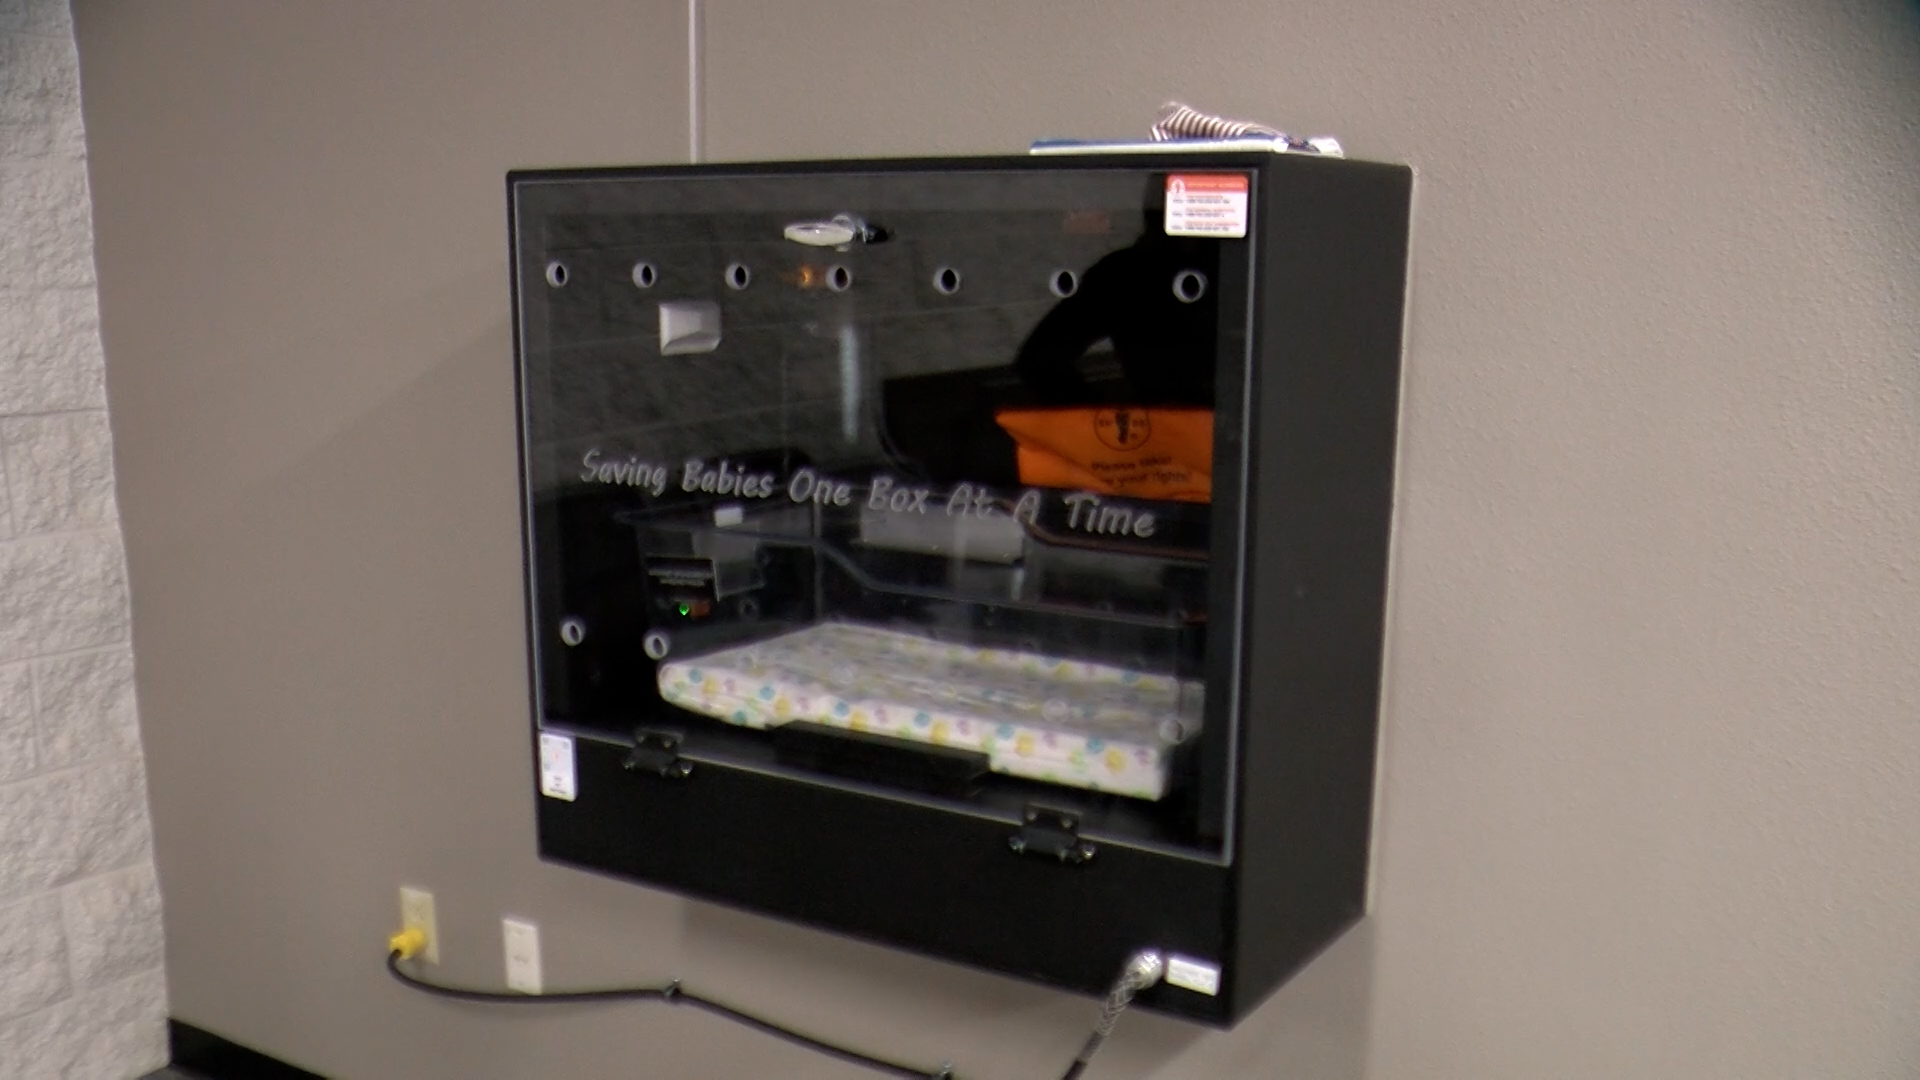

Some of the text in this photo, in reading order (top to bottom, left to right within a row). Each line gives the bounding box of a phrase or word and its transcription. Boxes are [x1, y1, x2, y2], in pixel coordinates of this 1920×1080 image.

[580, 449, 1156, 539] Saving Babies One Box At A Time
